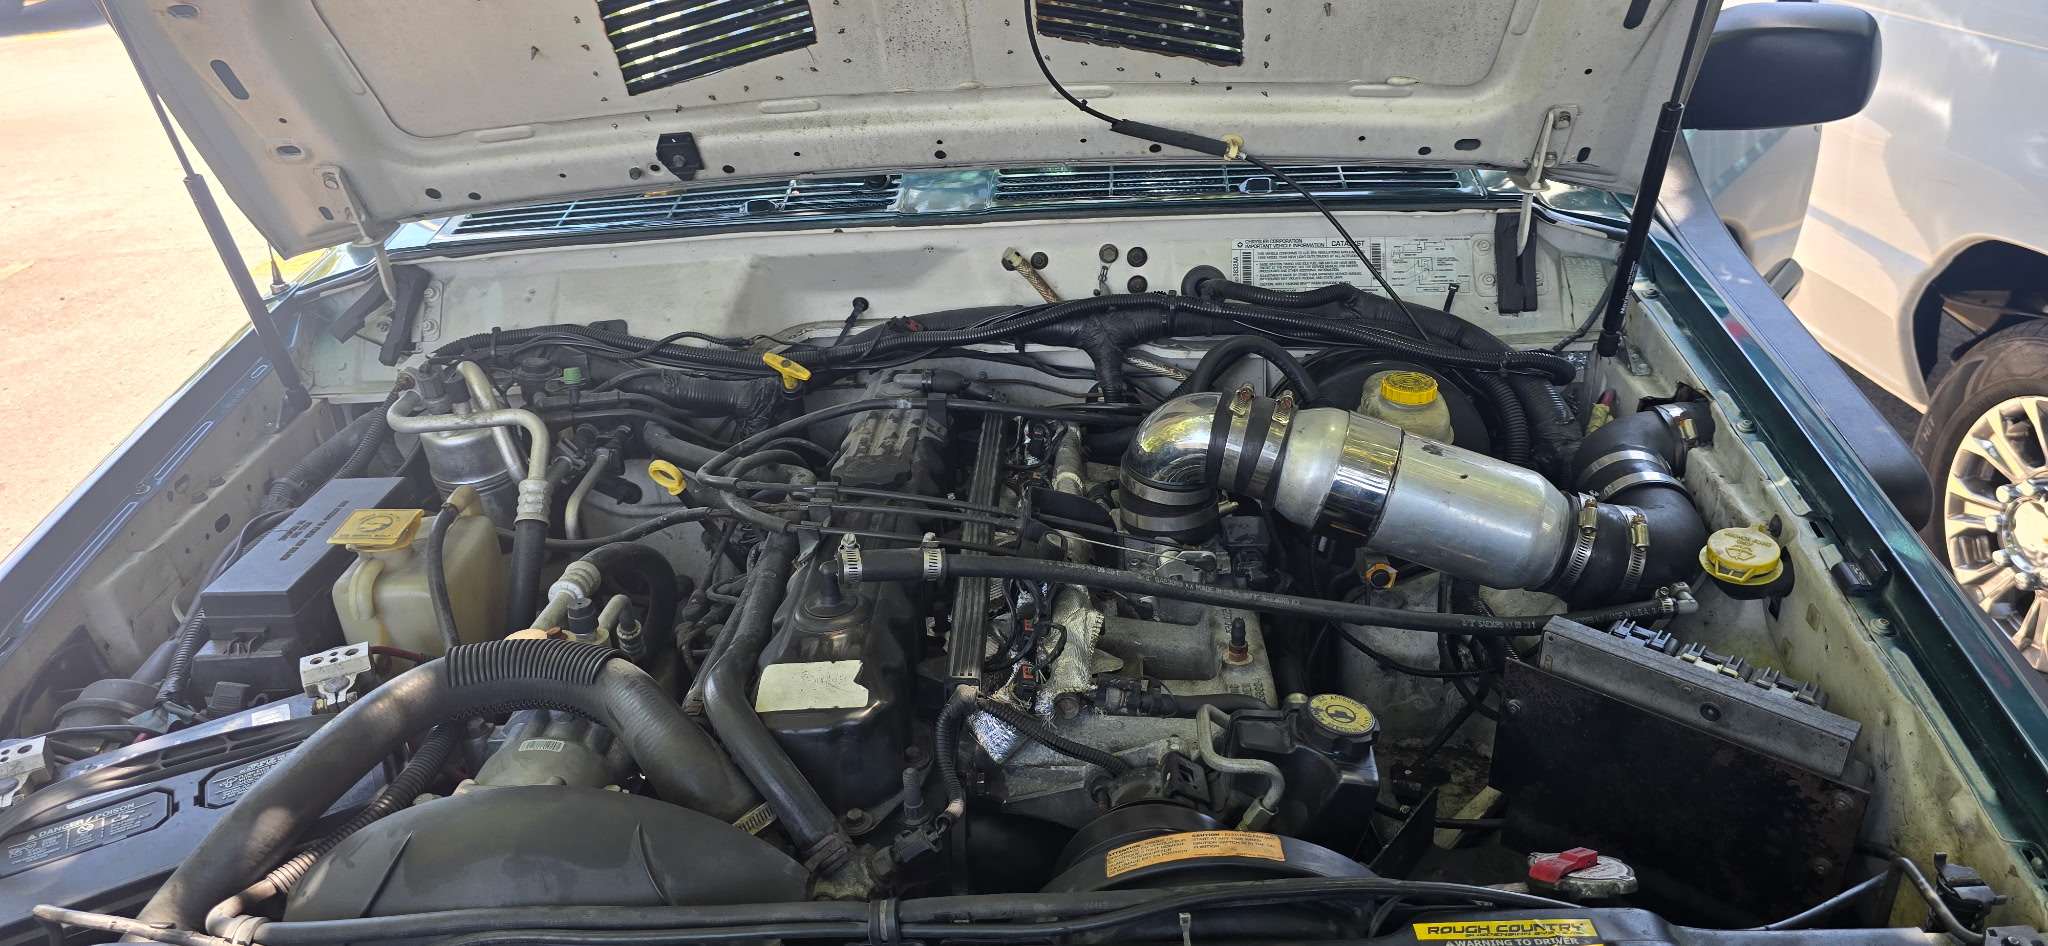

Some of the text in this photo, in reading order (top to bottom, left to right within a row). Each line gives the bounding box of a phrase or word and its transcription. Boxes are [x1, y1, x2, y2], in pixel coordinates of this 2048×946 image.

[1196, 584, 1214, 592] MADE
[38, 818, 85, 838] DANGER
[94, 802, 136, 820] POISON
[1108, 844, 1140, 856] ATTENTION
[1428, 924, 1582, 934] ROUGH COUNTRY
[1534, 936, 1580, 946] DRIVER
